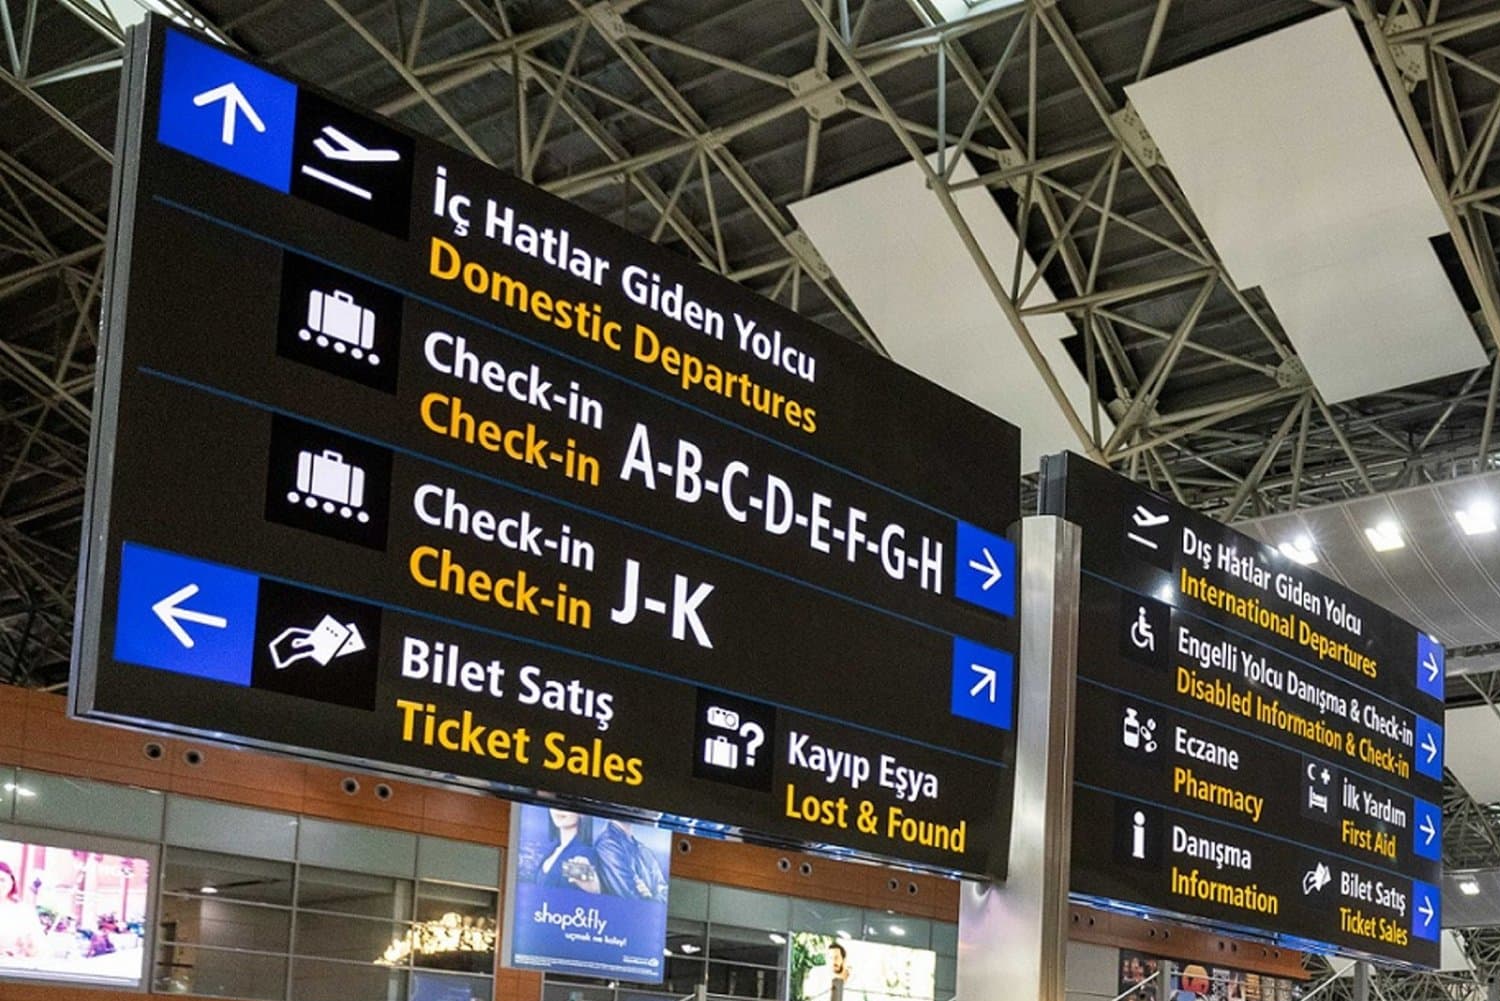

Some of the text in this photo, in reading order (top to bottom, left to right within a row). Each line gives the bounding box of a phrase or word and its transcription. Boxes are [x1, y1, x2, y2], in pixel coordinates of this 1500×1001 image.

[433, 165, 817, 383] İç Hatlar Giden Yolcu
[423, 331, 604, 430] Check-in
[429, 236, 818, 435] Domestic Departures
[419, 392, 600, 487] Check-in
[413, 483, 596, 573] Check-in
[619, 422, 944, 595] A-B-C-D-E-F-G-H
[409, 545, 592, 630] Check-in
[611, 558, 715, 650] J-K
[1180, 567, 1378, 680] International Departures
[1182, 526, 1362, 635] Dış Hatlar Giden Yolcu
[401, 635, 615, 732] Bilet Satış
[1176, 666, 1410, 780] Disabled Information & Check-in
[1178, 626, 1414, 748] Engelli Yolcu Danışma & Check-in
[396, 698, 644, 788] Ticket Sales
[787, 730, 939, 802] Kayıp Eşya
[1174, 726, 1239, 770] Eczane
[785, 783, 967, 854] Lost & Found
[1173, 767, 1264, 823] Pharmacy
[1341, 819, 1397, 859] First Aid
[1342, 776, 1407, 829] İlk Yardım
[1171, 866, 1278, 916] Information
[1172, 825, 1252, 870] Danışma
[534, 902, 608, 935] shop&fly
[1339, 906, 1409, 947] Ticket Sales
[1340, 870, 1407, 917] Bilet Satış
